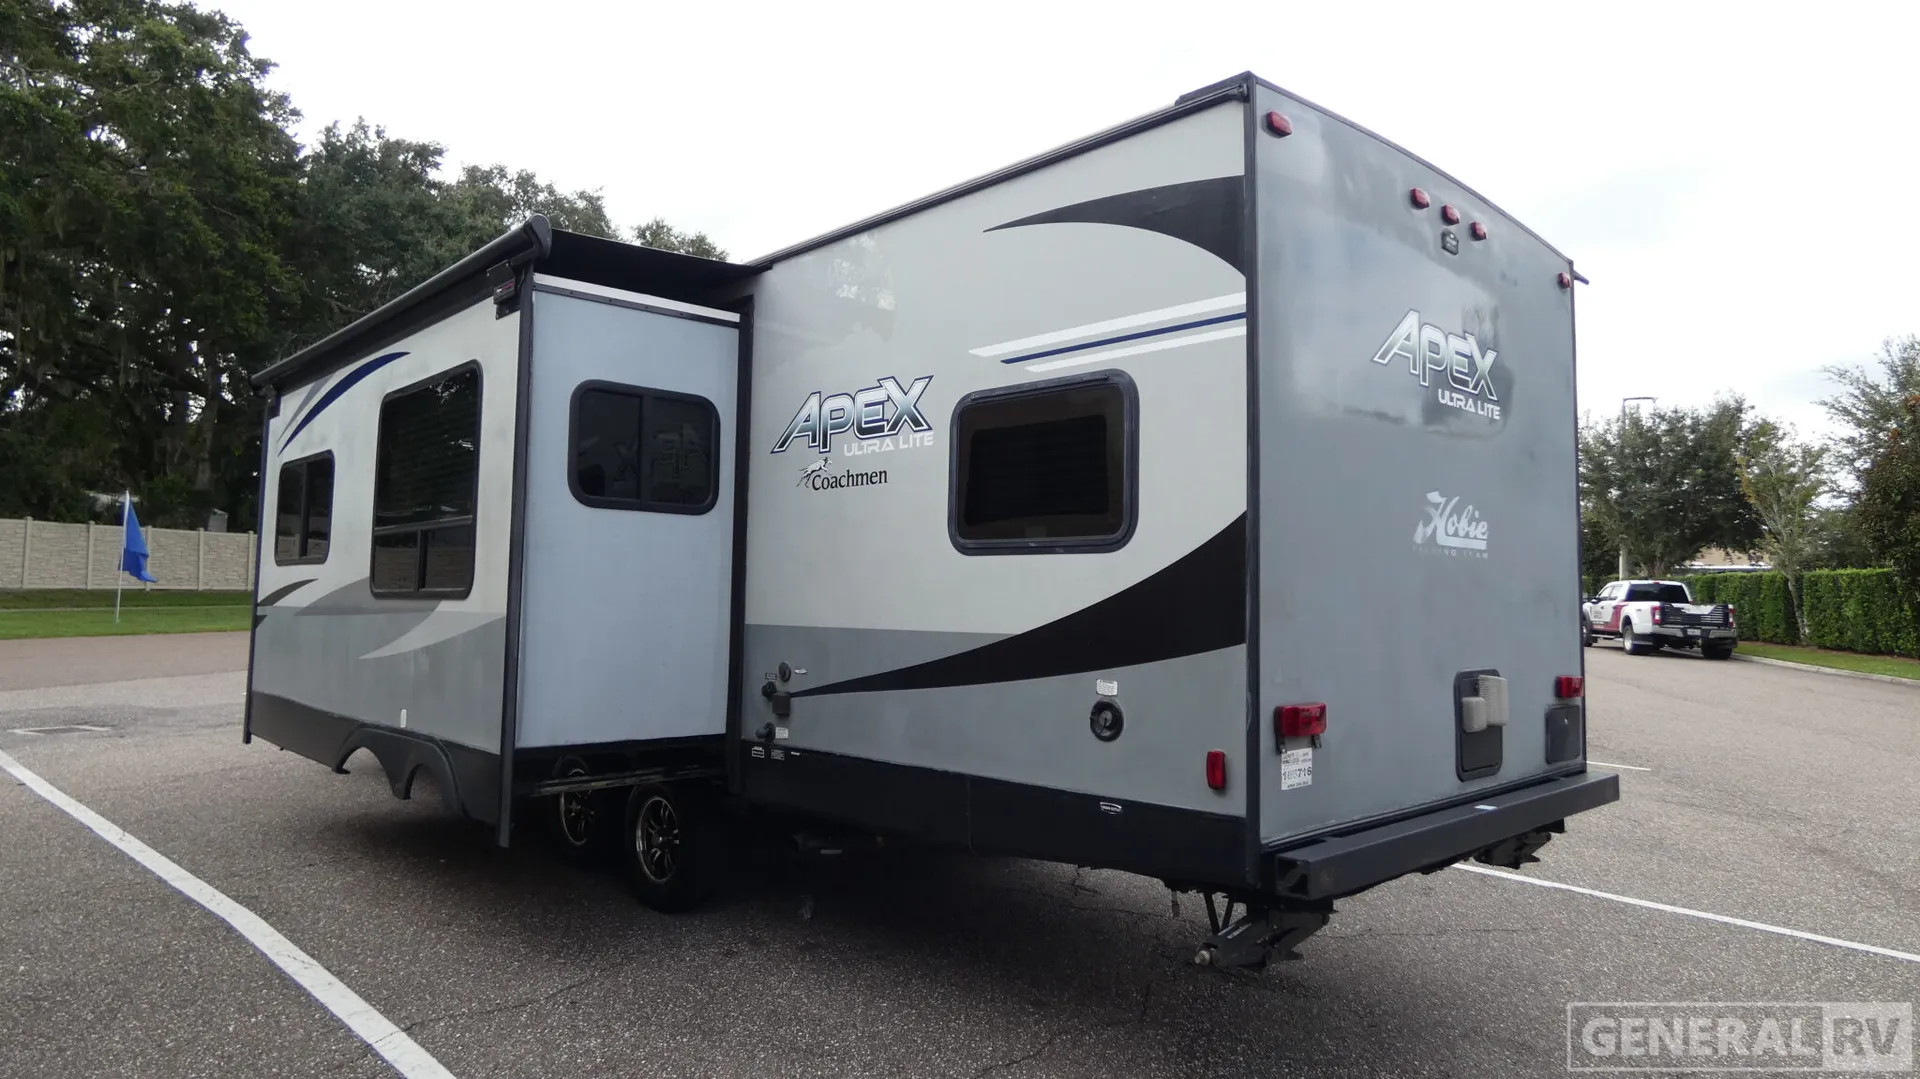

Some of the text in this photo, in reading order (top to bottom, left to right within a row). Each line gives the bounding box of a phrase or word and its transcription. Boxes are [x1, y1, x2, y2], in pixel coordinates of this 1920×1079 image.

[1371, 308, 1499, 401] APEX
[770, 375, 934, 454] APEX
[1437, 388, 1501, 420] ULTRA LITE
[843, 431, 935, 457] ULTRA LITE
[812, 469, 888, 491] Coachmen
[1413, 491, 1488, 550] Hobie
